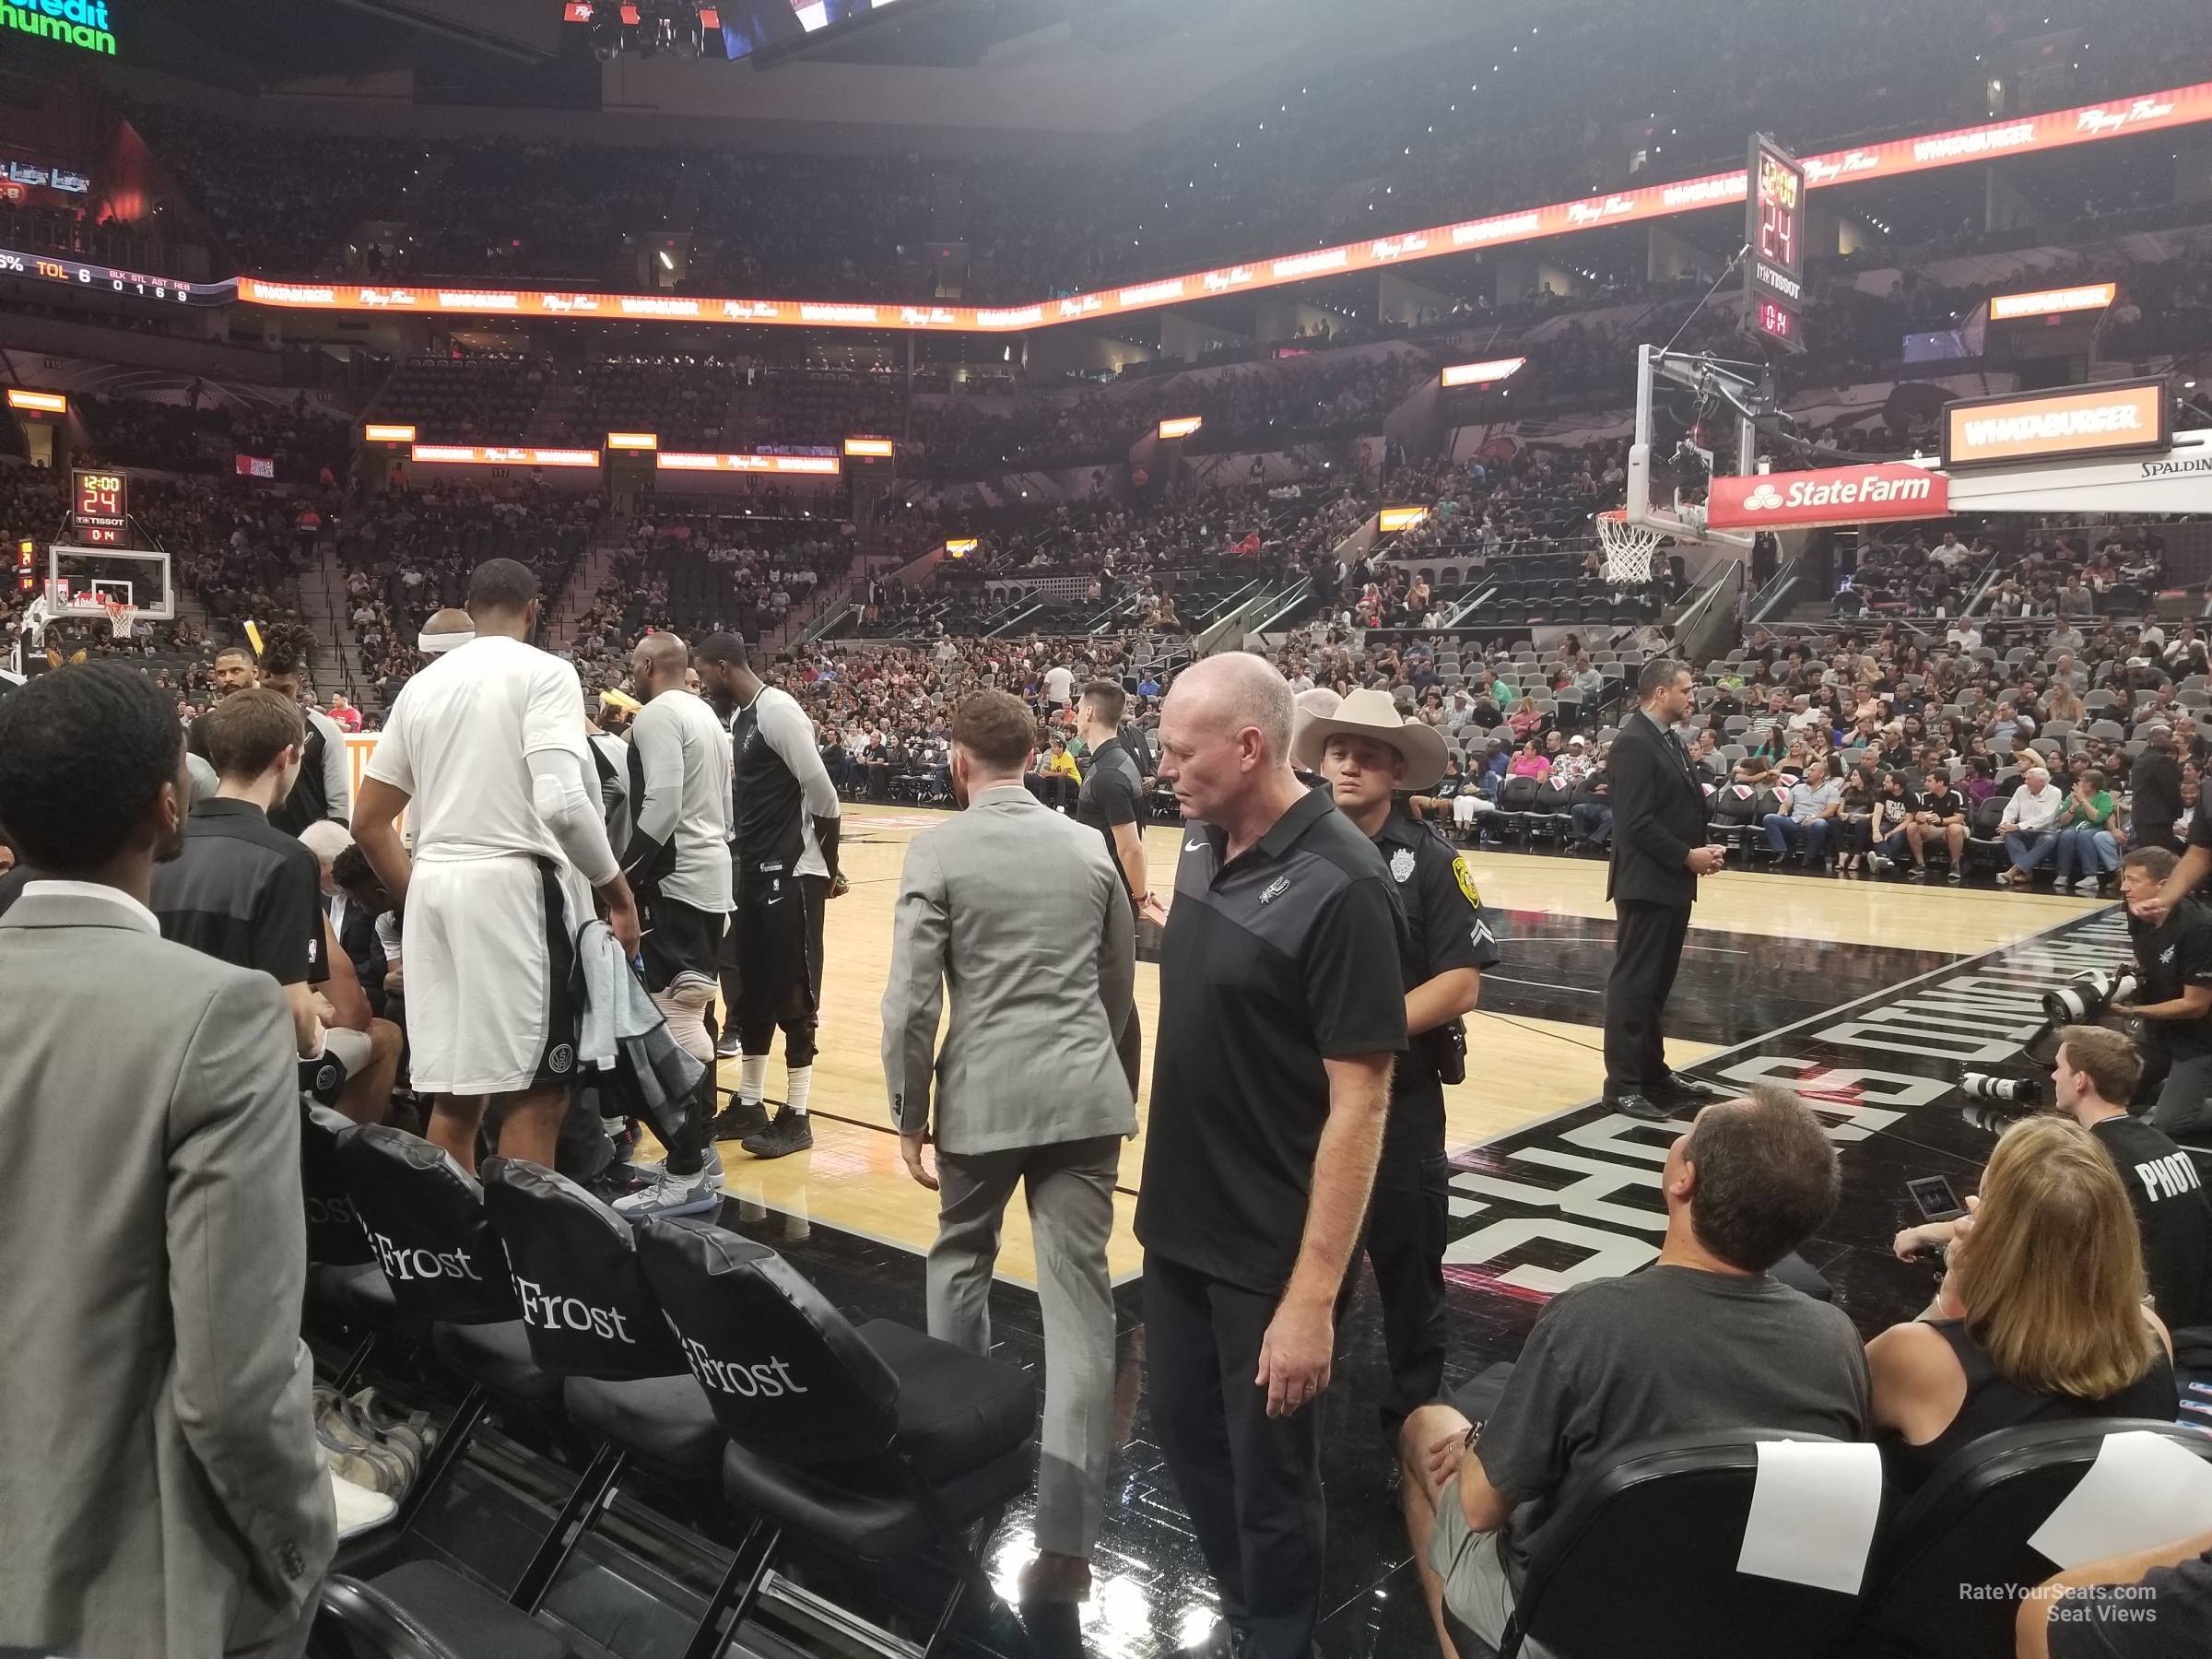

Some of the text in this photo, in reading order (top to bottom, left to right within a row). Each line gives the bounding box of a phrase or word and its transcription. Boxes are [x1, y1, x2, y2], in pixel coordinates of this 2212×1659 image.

[7, 0, 108, 30] edit
[37, 262, 69, 279] TOL
[78, 268, 91, 283] 6
[110, 270, 190, 291] BLK STL AST REB
[1770, 268, 1800, 300] TISSOT
[113, 279, 187, 302] 0 1 6 9
[1964, 404, 2142, 448] WHATABURGER
[84, 476, 120, 491] 12:00
[84, 489, 115, 513] 24
[90, 517, 124, 526] TISSOT
[309, 1193, 357, 1224] ost
[374, 1232, 482, 1281] Frost
[517, 1275, 636, 1344] Frost
[688, 1336, 808, 1398] Frost
